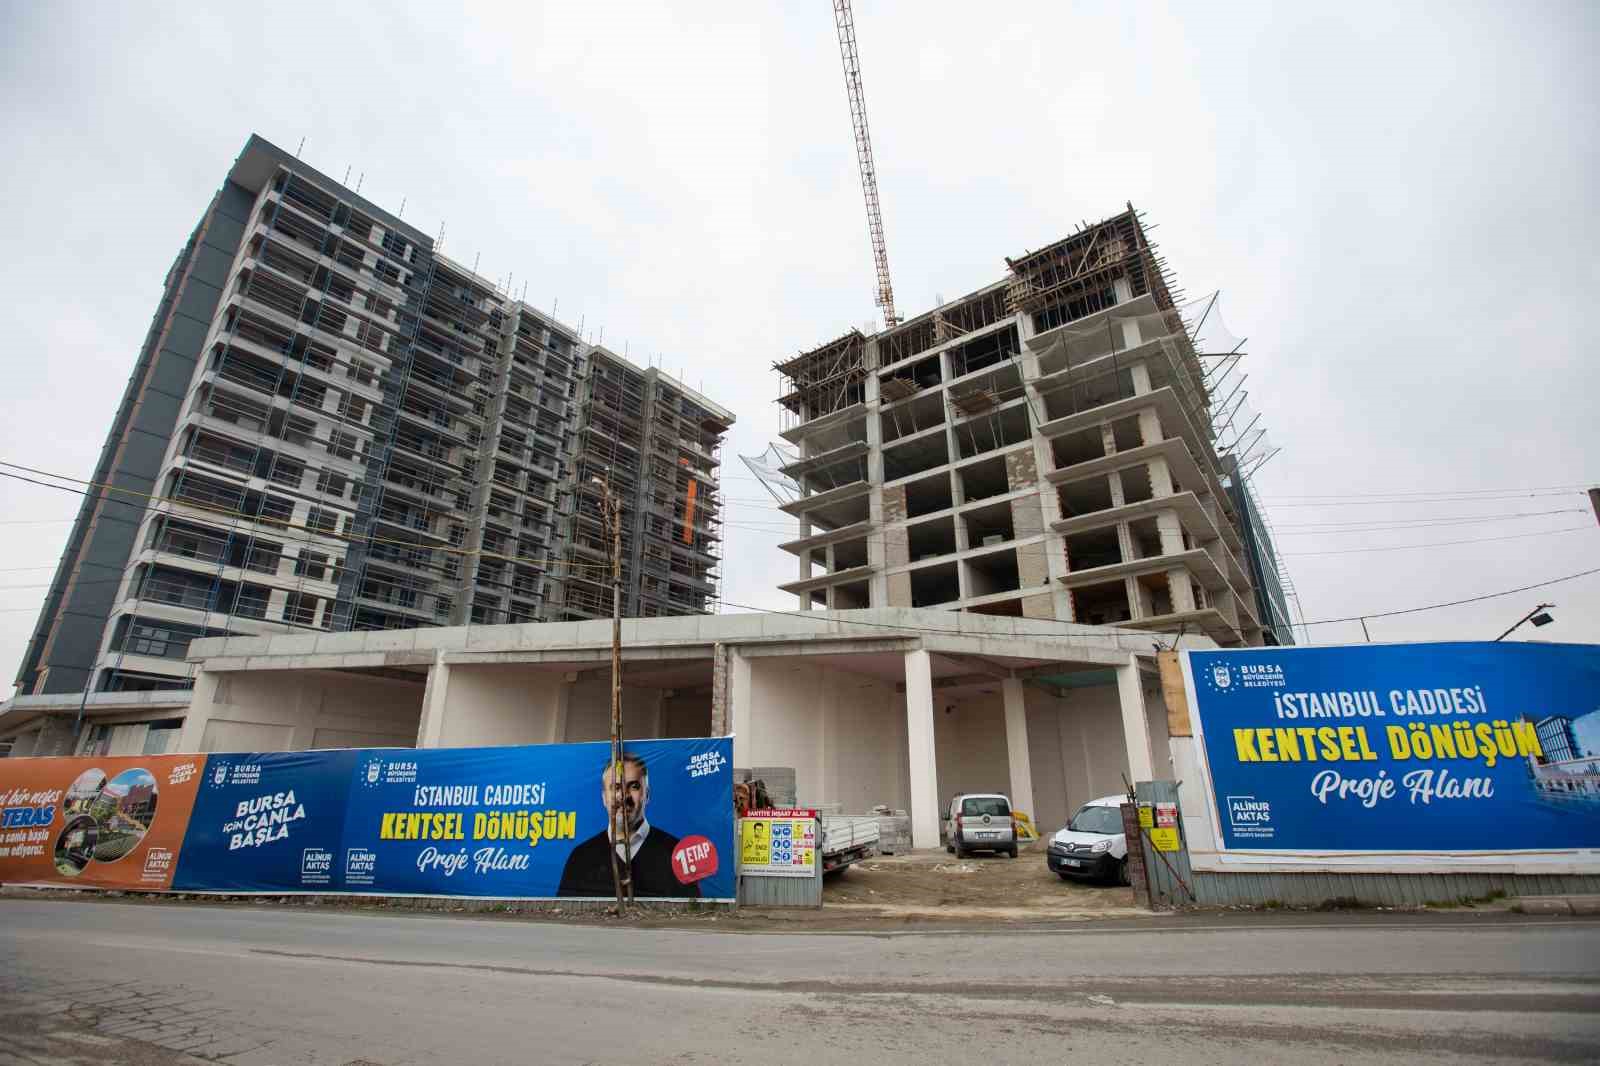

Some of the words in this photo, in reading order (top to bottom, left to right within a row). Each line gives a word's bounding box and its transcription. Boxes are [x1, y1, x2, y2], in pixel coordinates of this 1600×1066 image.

[1241, 664, 1282, 674] BURSA
[1244, 680, 1286, 688] BELEDİYESİ
[1273, 689, 1386, 720] İSTANBUL
[1391, 685, 1487, 716] CADDESİ
[1232, 727, 1378, 762] KENTSEL
[1386, 720, 1544, 768] DÖNÜŞÜM
[388, 762, 418, 771] BURSA
[691, 751, 720, 764] BURSA
[696, 756, 726, 770] CANLA
[414, 784, 479, 806] İSTANBUL
[484, 782, 546, 806] CADDESİ
[1311, 769, 1396, 808] Proje
[1402, 769, 1494, 804] Alanı
[236, 790, 296, 818] BURSA
[1233, 800, 1270, 811] ALİNUR
[2, 805, 56, 828] TERAS
[244, 804, 306, 831] CANLA
[229, 824, 288, 850] BAŞLA
[380, 812, 464, 840] KENTSEL
[473, 810, 576, 847] DÖNÜŞÜM
[306, 852, 332, 862] ALİNUR
[350, 853, 376, 862] ALİNUR
[416, 846, 469, 876] Proje
[473, 847, 530, 874] Alanı
[686, 842, 711, 863] ETAP
